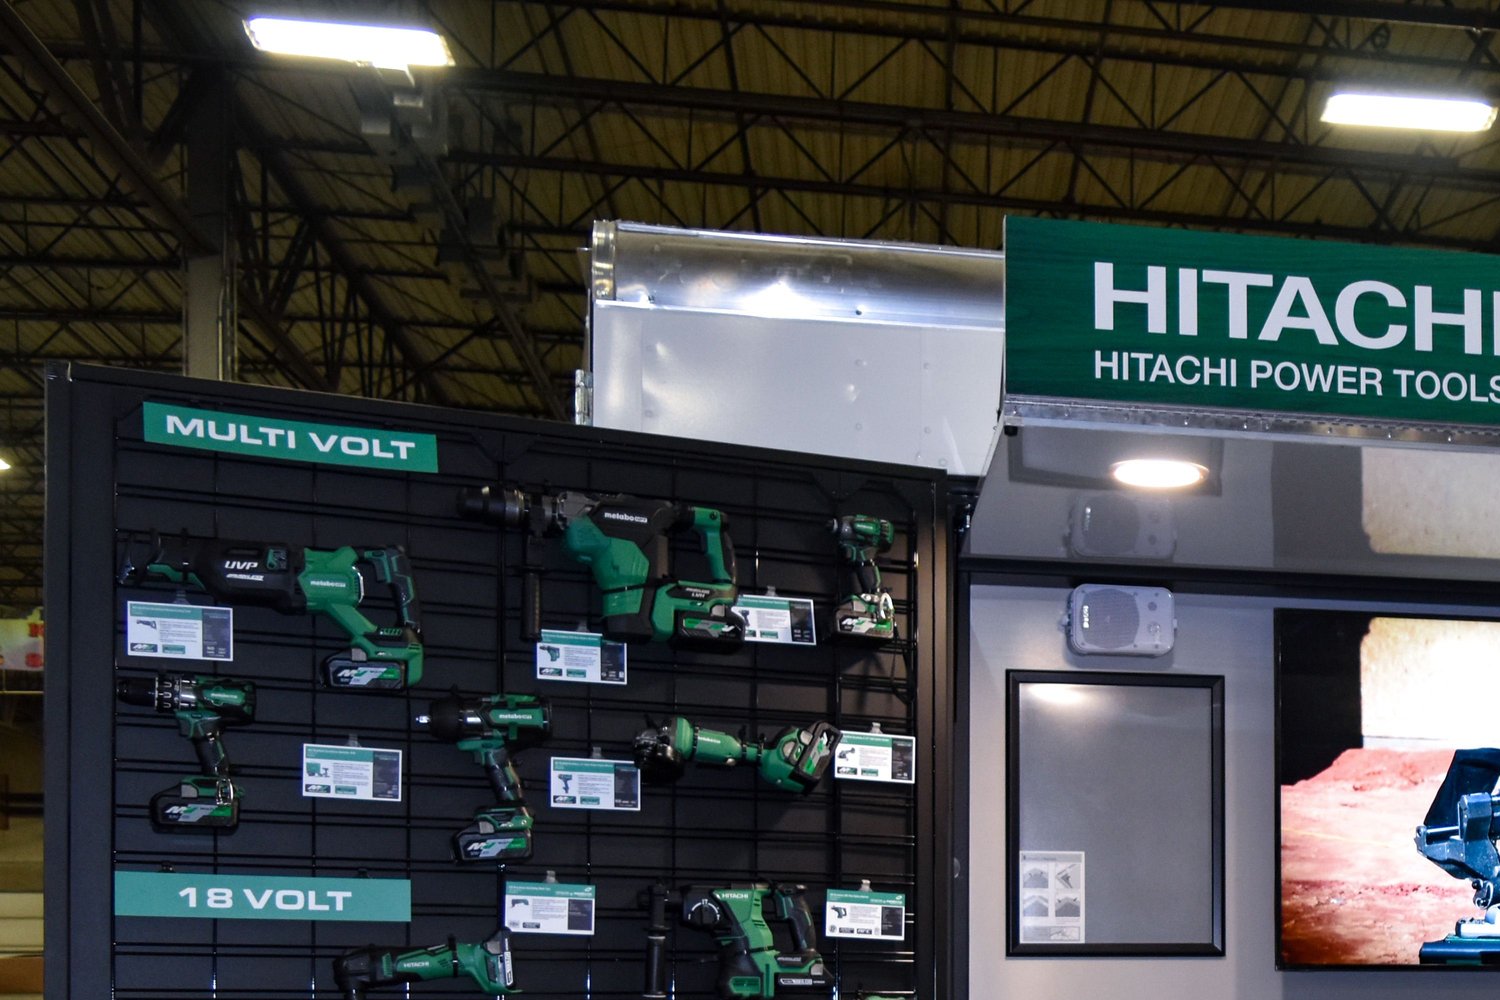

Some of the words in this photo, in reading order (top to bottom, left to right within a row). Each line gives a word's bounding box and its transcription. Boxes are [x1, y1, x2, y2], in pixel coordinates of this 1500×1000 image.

[1094, 350, 1238, 388] HITACHI
[1251, 360, 1383, 396] POWER
[166, 415, 297, 449] MULTI
[308, 432, 416, 459] VOLT
[225, 560, 259, 571] UVP
[178, 887, 234, 909] 18
[243, 889, 352, 912] VOLT
[721, 891, 750, 900] HITACHI
[403, 960, 430, 969] HITACHI
